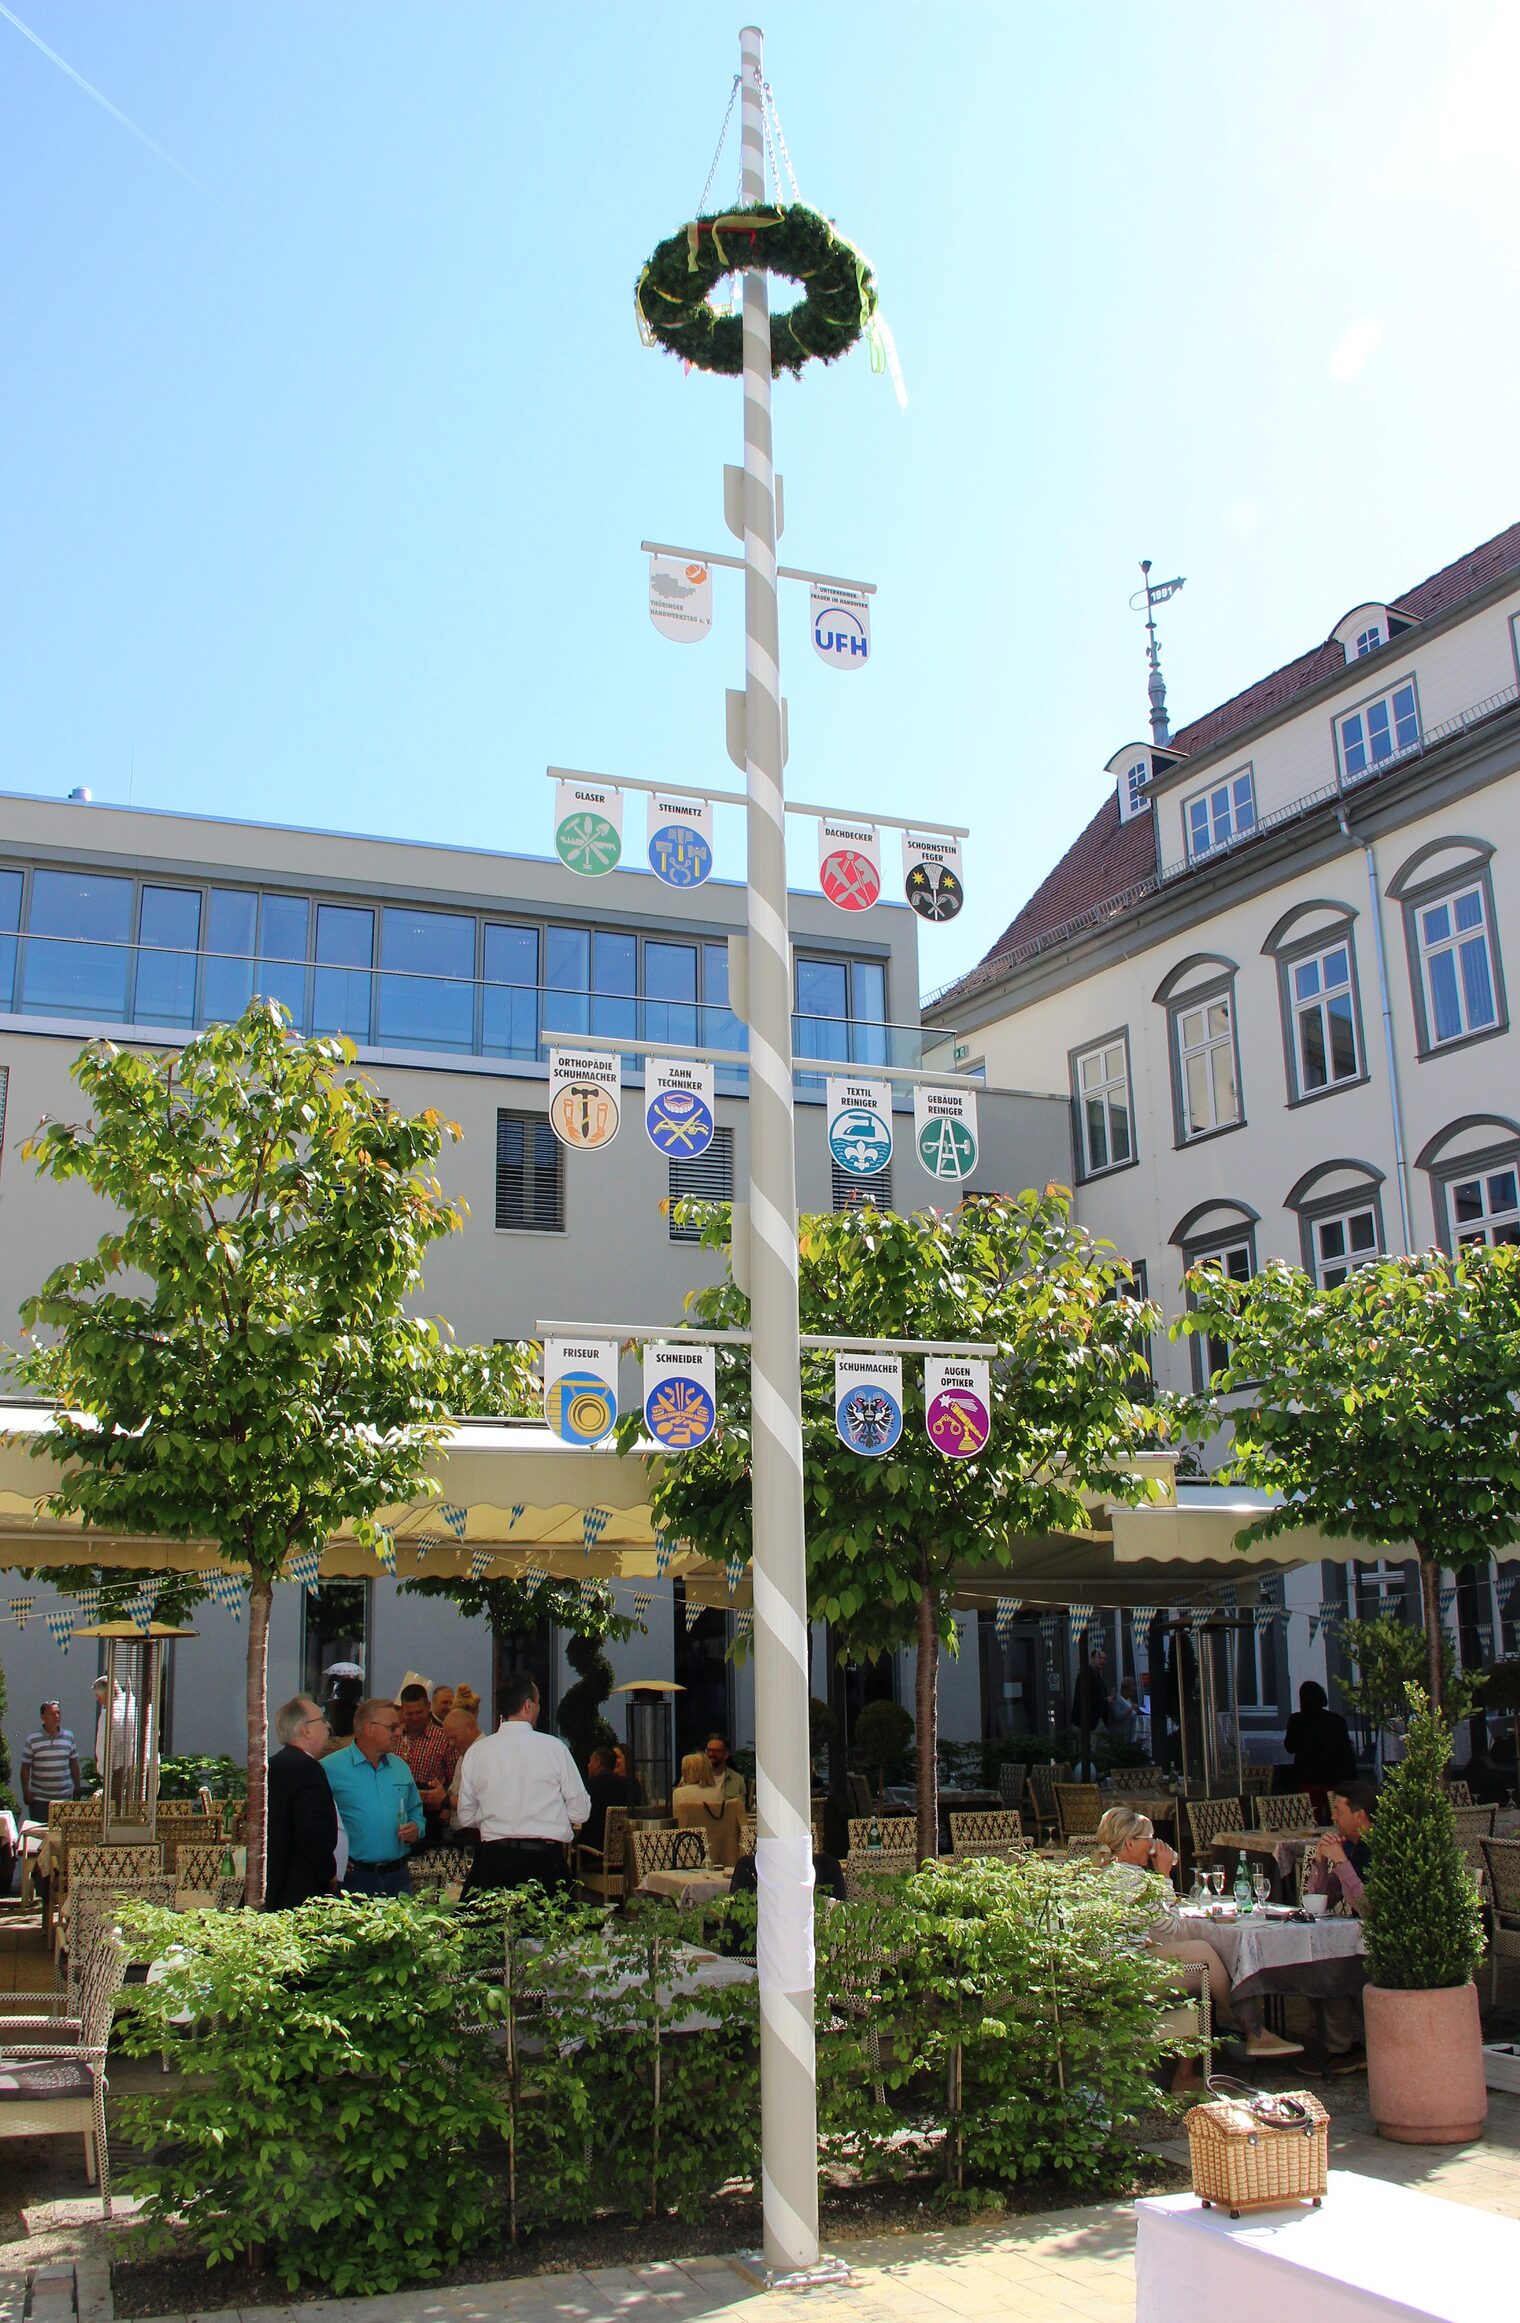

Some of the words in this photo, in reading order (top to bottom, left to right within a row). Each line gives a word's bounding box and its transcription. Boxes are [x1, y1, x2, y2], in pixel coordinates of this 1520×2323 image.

[1151, 585, 1173, 602] 1991
[811, 593, 830, 602] FRAUEN
[840, 599, 868, 609] HANDWERK
[650, 609, 697, 622] HANDWERKSTAG
[815, 629, 867, 657] UFH
[575, 791, 605, 804] GLASER
[659, 803, 702, 817] STEINMETZ
[825, 828, 873, 842] DACHDECKER
[907, 840, 957, 854] SCHORNSTEIN
[921, 852, 944, 862] FEGER
[558, 1057, 613, 1071] ORTHOPÄDIE
[553, 1068, 617, 1083] SCHUHMACHER
[668, 1068, 692, 1079] ZAHN
[657, 1078, 703, 1091] TECHNIKER
[846, 1087, 872, 1098] TEXTIL
[841, 1097, 878, 1109] REINIGER
[927, 1094, 963, 1106] GEBÄUDE
[928, 1106, 963, 1117] REINIGER
[563, 1348, 600, 1359] FRISEUR
[656, 1353, 703, 1364] SCHNEIDER
[838, 1362, 898, 1374] SCHUHMACHER
[944, 1366, 971, 1377] AUGEN
[940, 1377, 974, 1388] OPTIKER
